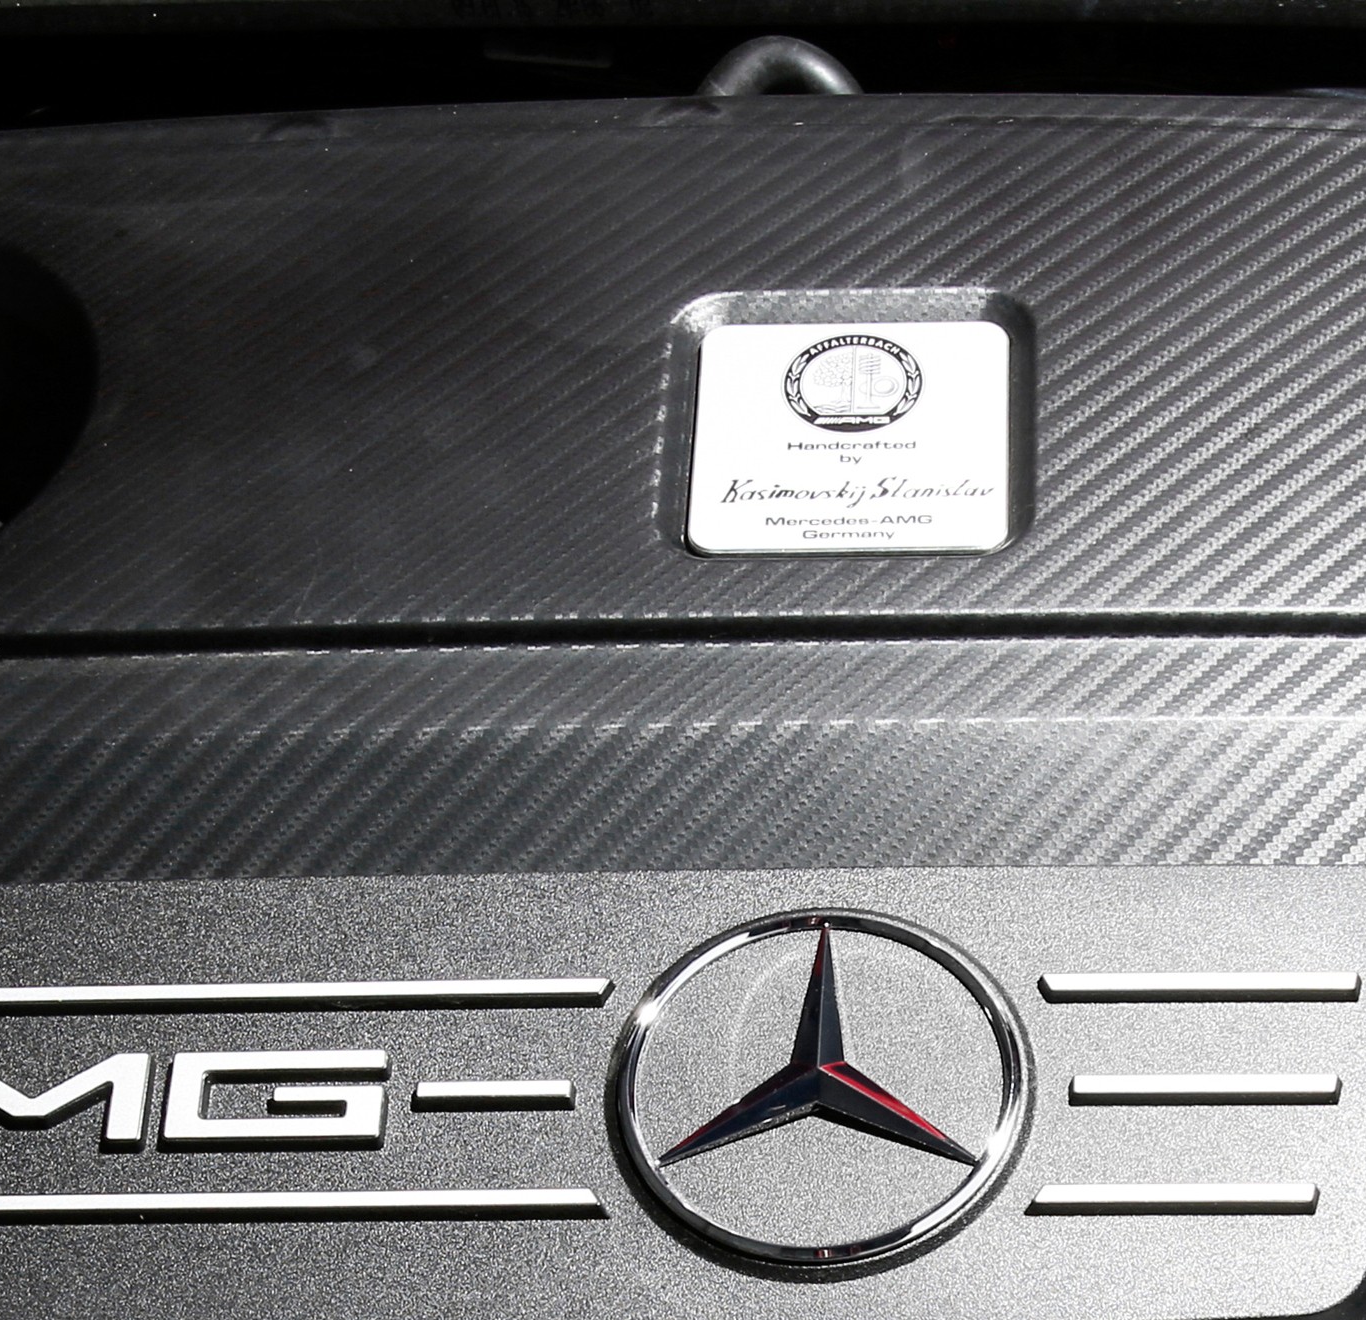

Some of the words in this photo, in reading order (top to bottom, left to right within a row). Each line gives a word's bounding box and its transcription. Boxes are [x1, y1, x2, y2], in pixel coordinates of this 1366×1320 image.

[809, 336, 902, 355] AFFALTERBACH
[787, 441, 917, 451] Handcrafted
[839, 454, 863, 464] by
[764, 514, 933, 526] Mercedes-AMG
[802, 529, 895, 540] Germany
